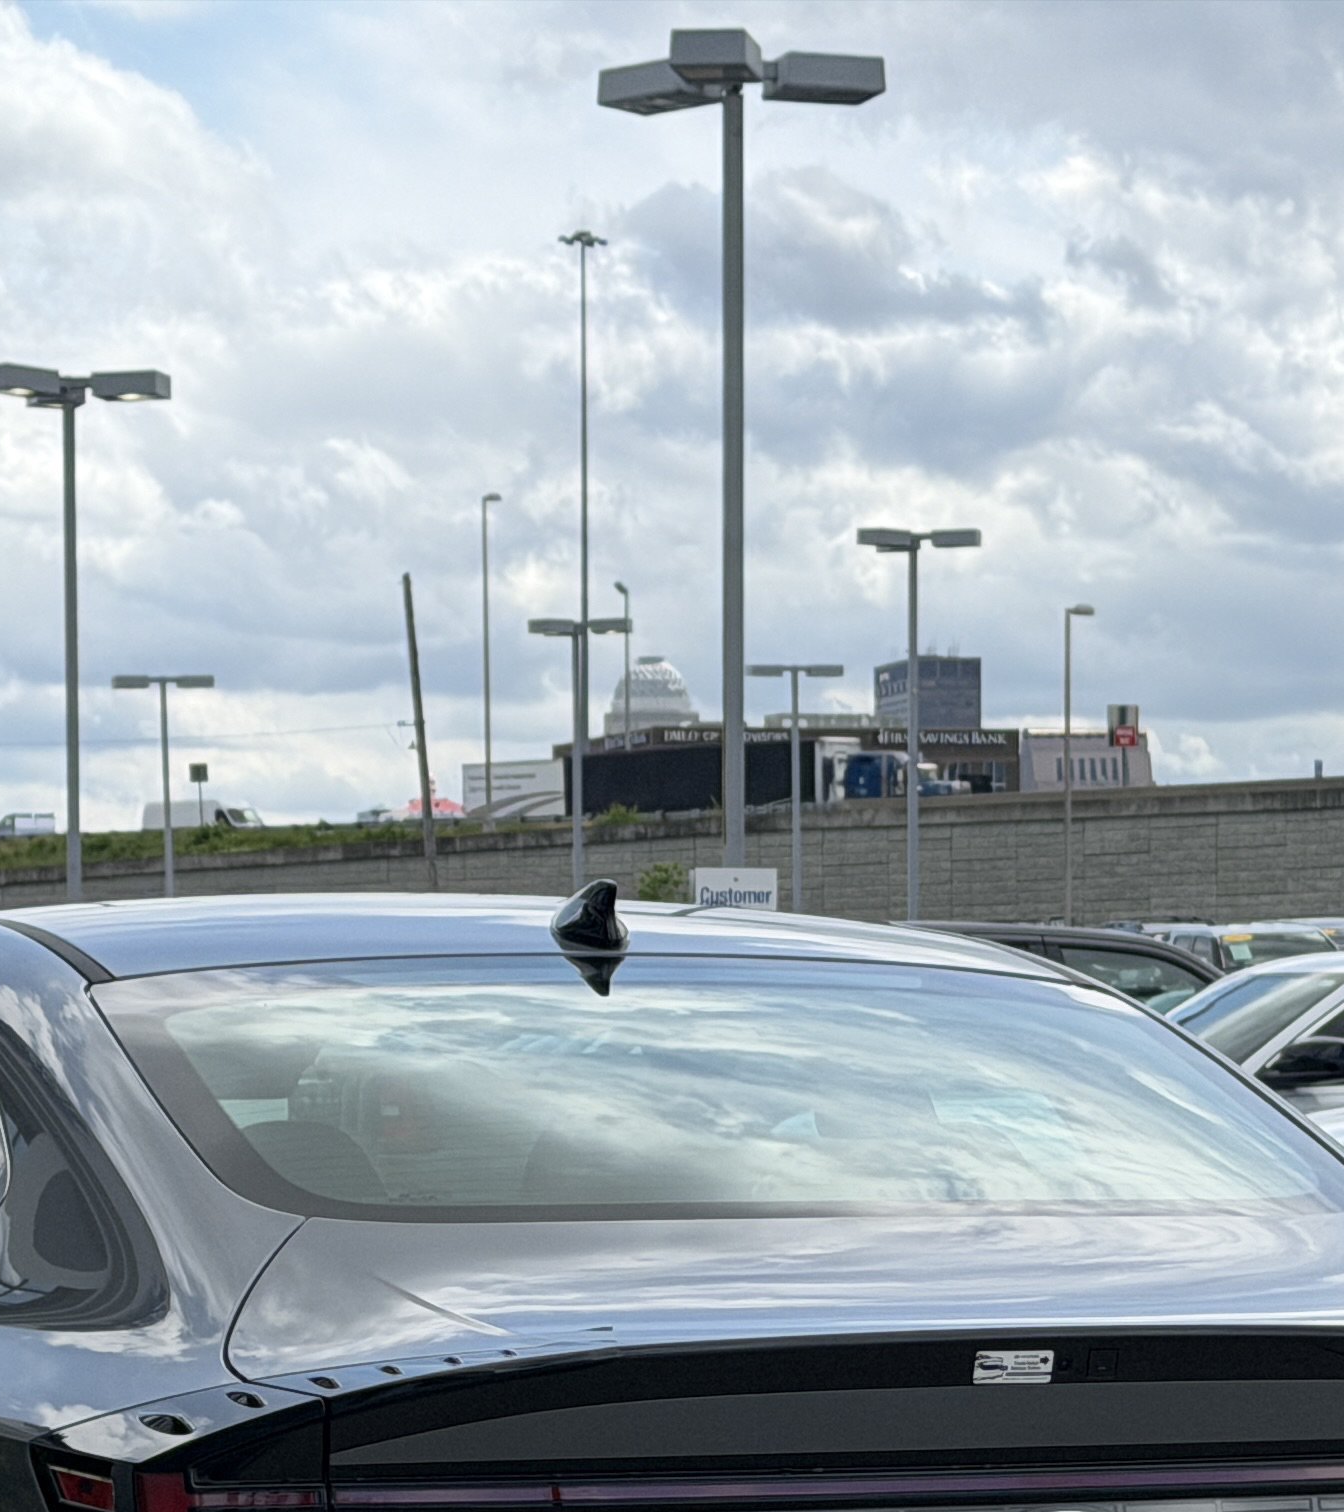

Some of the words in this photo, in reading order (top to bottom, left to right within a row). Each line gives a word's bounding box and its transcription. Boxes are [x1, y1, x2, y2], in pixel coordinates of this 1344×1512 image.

[884, 728, 909, 745] FIRS
[971, 730, 1007, 745] BANK
[699, 886, 772, 907] Customer
